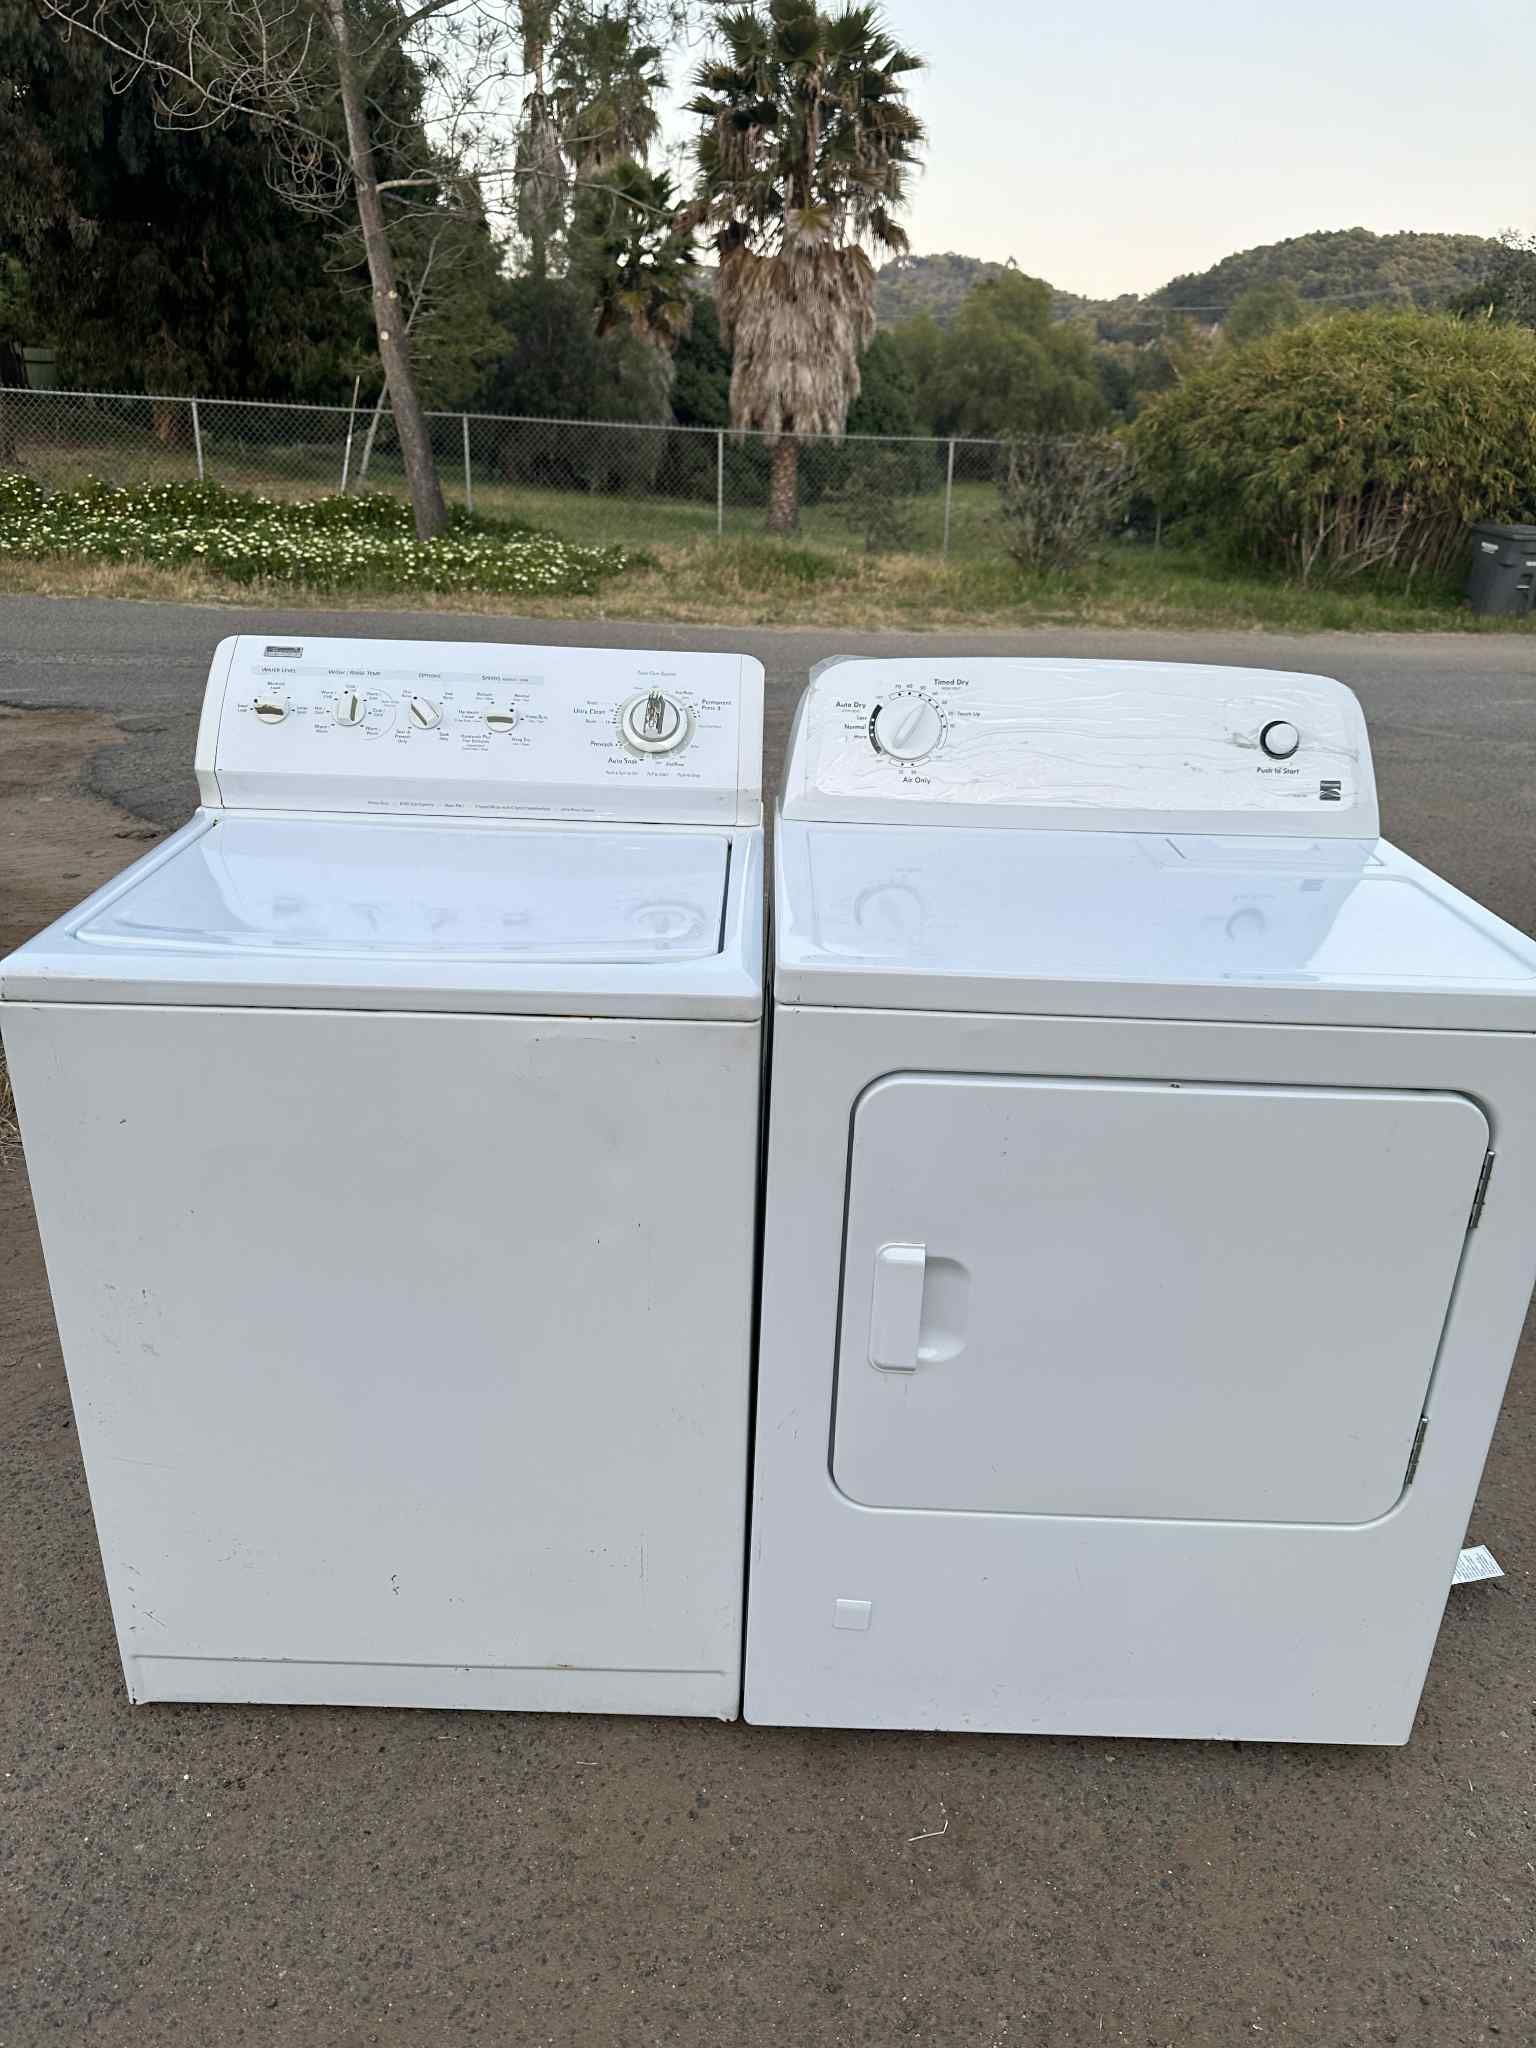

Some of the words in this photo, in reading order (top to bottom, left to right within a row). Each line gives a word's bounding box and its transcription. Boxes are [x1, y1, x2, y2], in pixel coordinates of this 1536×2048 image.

[933, 678, 955, 686] Timed
[956, 678, 969, 687] Dry
[853, 701, 866, 709] Dry
[1256, 766, 1273, 774] Push
[1282, 767, 1300, 775] Start
[914, 777, 931, 785] Only
